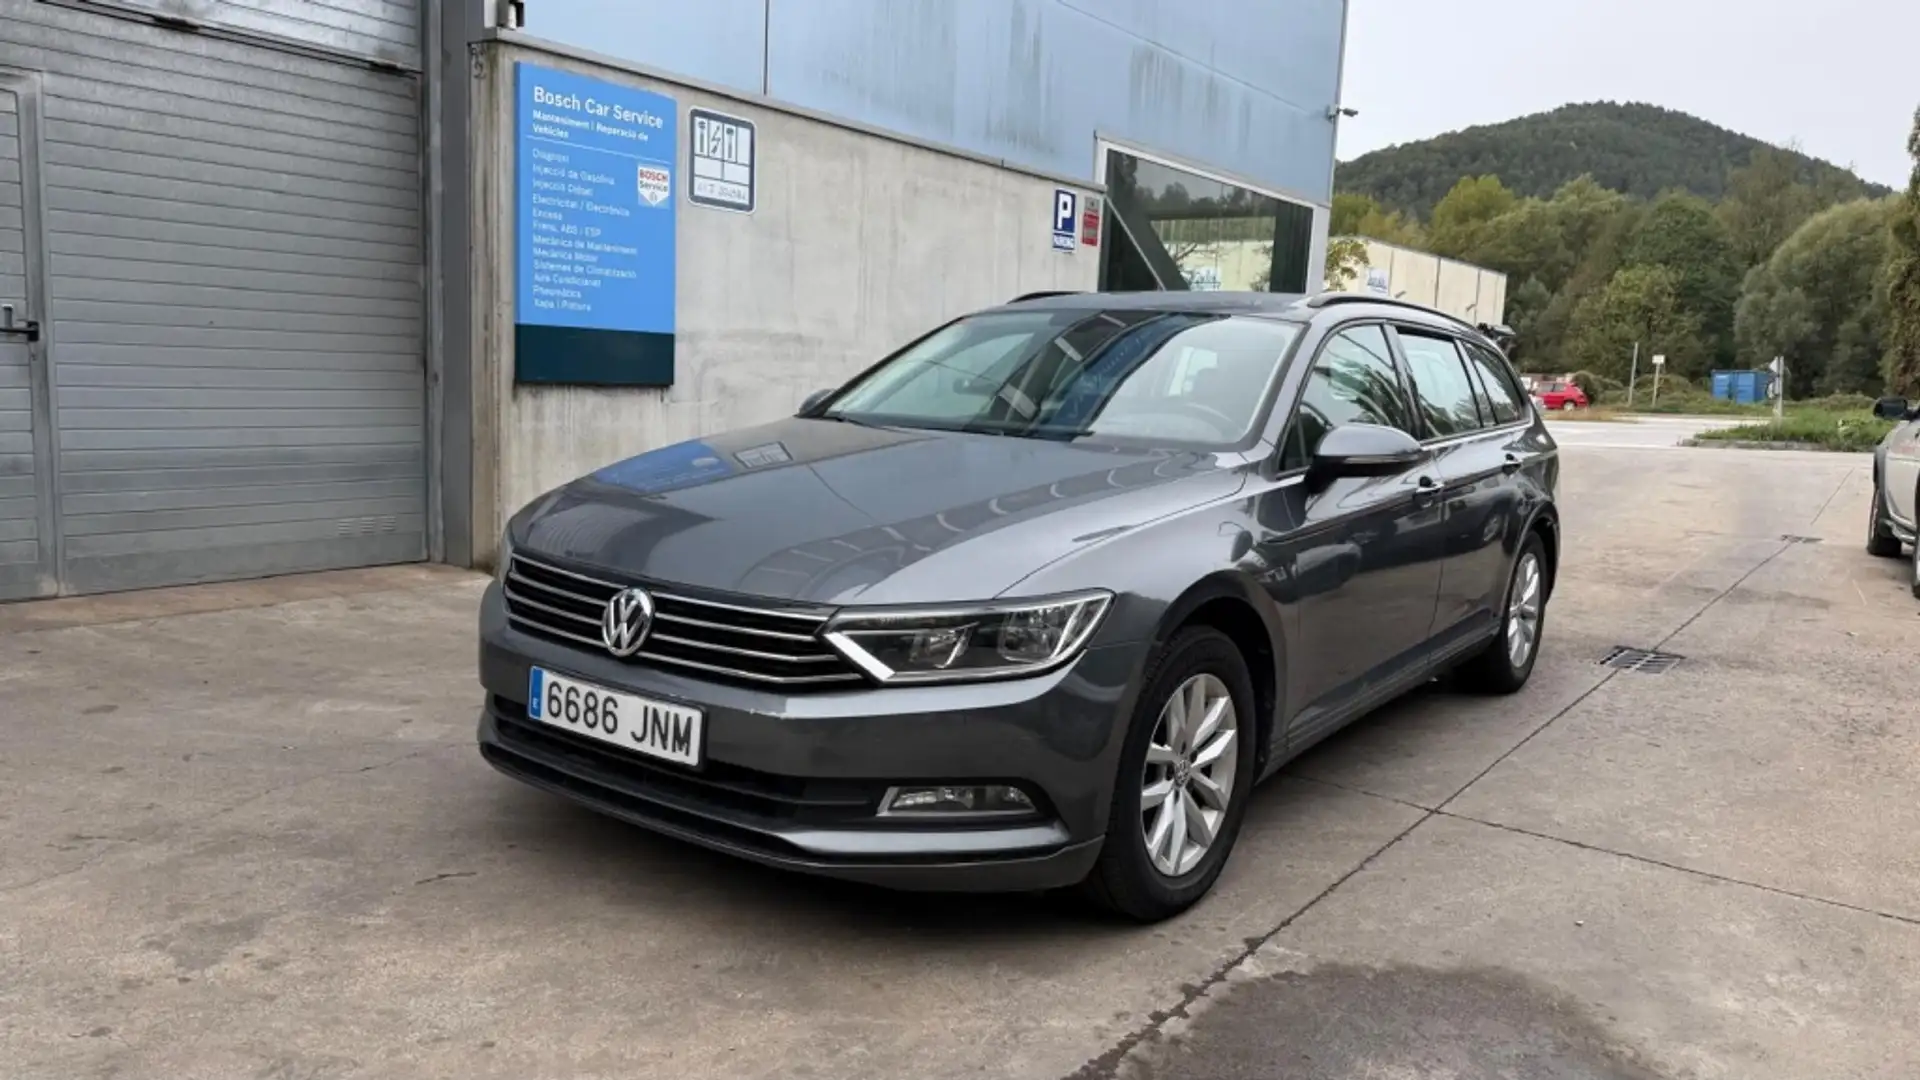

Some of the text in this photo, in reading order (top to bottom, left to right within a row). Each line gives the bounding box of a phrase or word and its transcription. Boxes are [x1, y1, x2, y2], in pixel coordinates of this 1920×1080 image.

[533, 85, 664, 129] Bosch Car Service
[639, 168, 668, 183] BOSCH
[639, 180, 668, 193] Service
[1056, 193, 1072, 229] P
[547, 680, 693, 757] 6686 JNM
